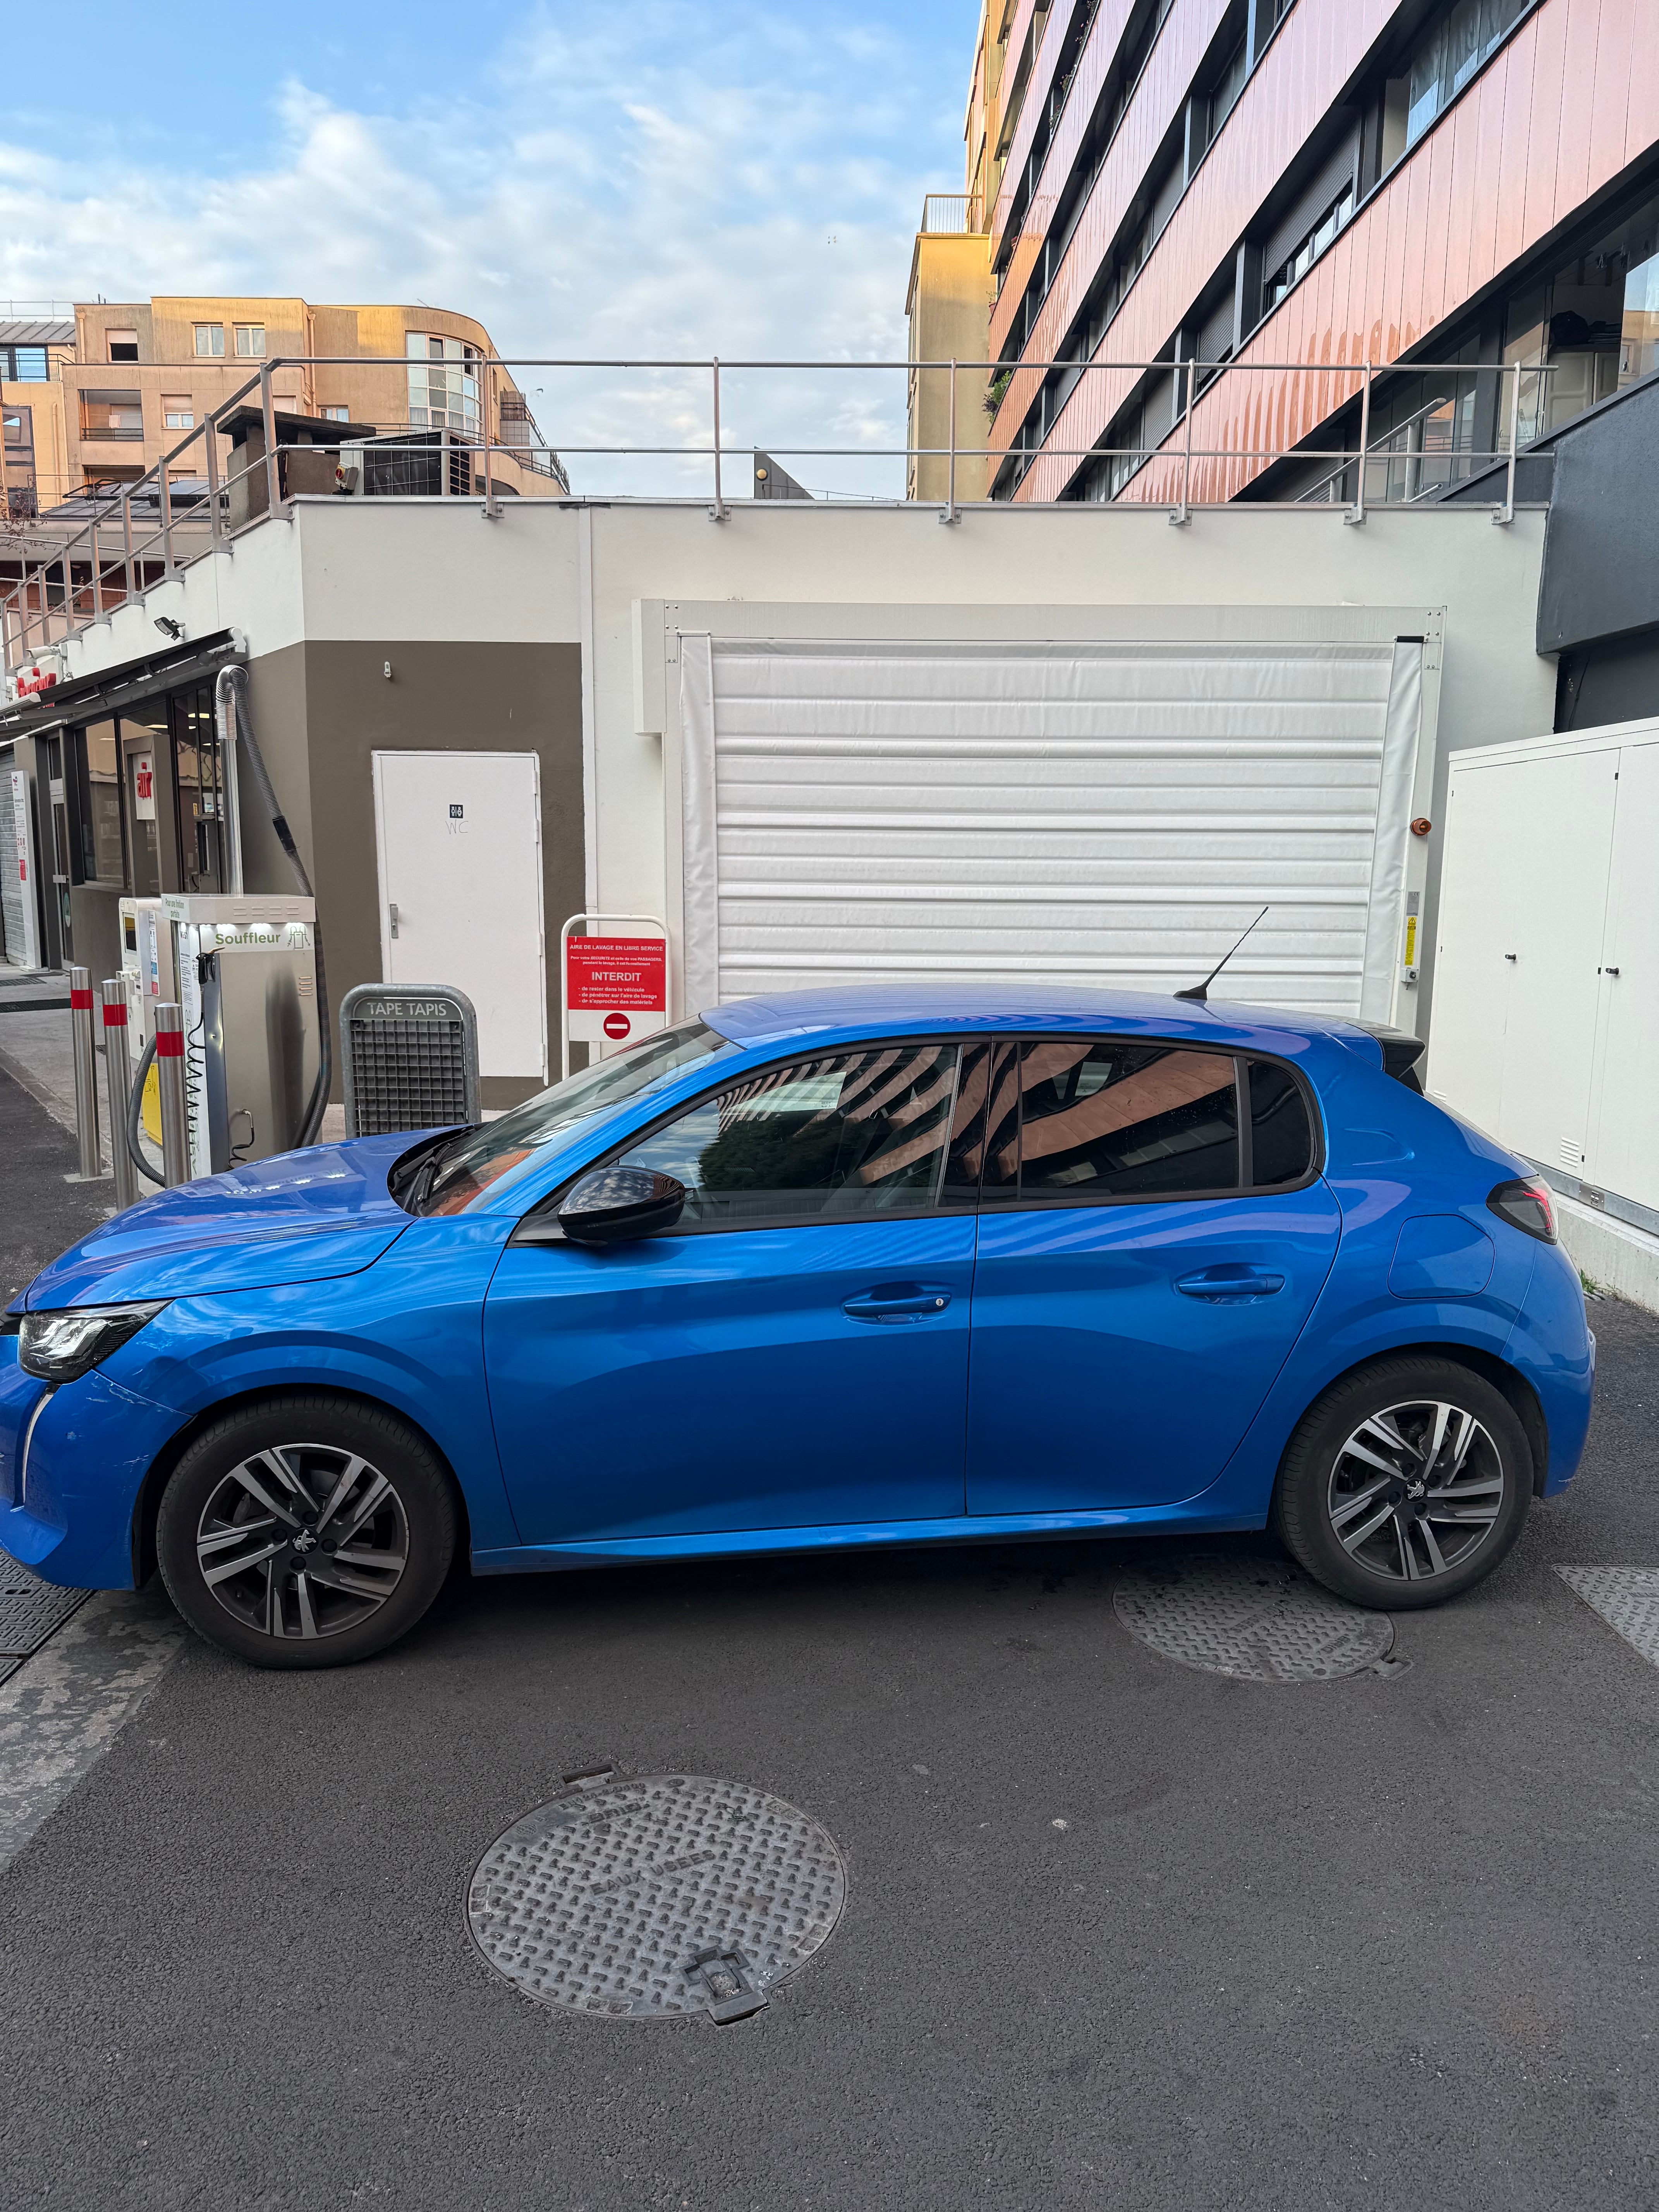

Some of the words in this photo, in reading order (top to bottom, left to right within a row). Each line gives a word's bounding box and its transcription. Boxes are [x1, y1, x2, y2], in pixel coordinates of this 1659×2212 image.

[137, 762, 152, 798] air
[445, 819, 468, 834] WC
[215, 932, 281, 945] Souffleur
[592, 972, 642, 981] INTERDIT
[367, 1002, 403, 1015] TAPE
[406, 1003, 447, 1016] TAPIS
[589, 1870, 646, 1896] EAUX
[649, 1850, 716, 1876] USEES
